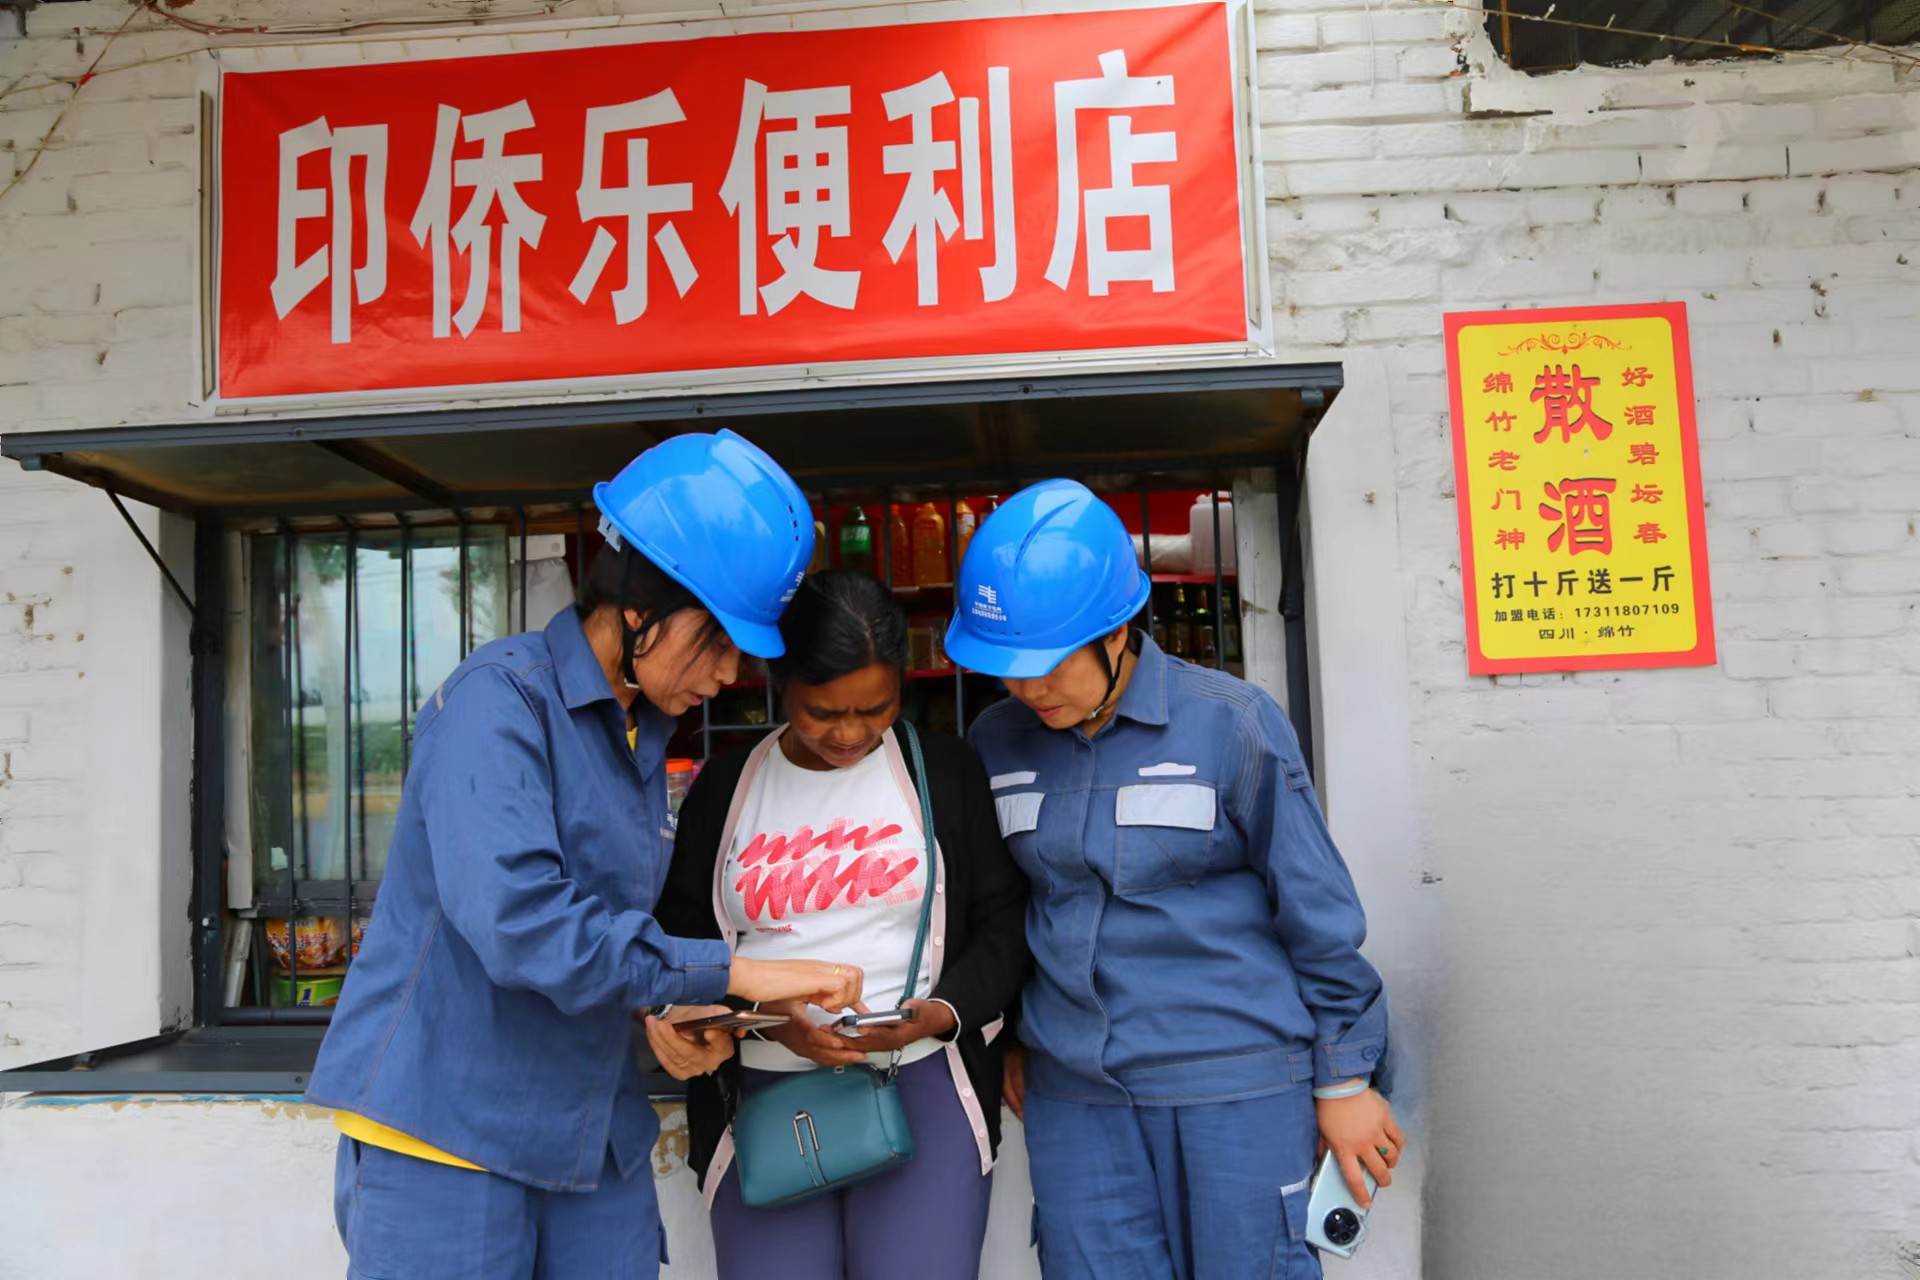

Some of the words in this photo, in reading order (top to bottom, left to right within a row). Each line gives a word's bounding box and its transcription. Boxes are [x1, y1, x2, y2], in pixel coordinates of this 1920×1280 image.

[269, 49, 1178, 345] 印侨乐便利店
[1482, 372, 1526, 550] 绵竹老门神
[1530, 364, 1617, 557] 散酒
[1621, 366, 1667, 544] 好酒碧坛春
[1491, 565, 1675, 599] 打十斤送一斤
[1494, 607, 1564, 622] 加盟电话：
[1574, 603, 1680, 618] 17311807109
